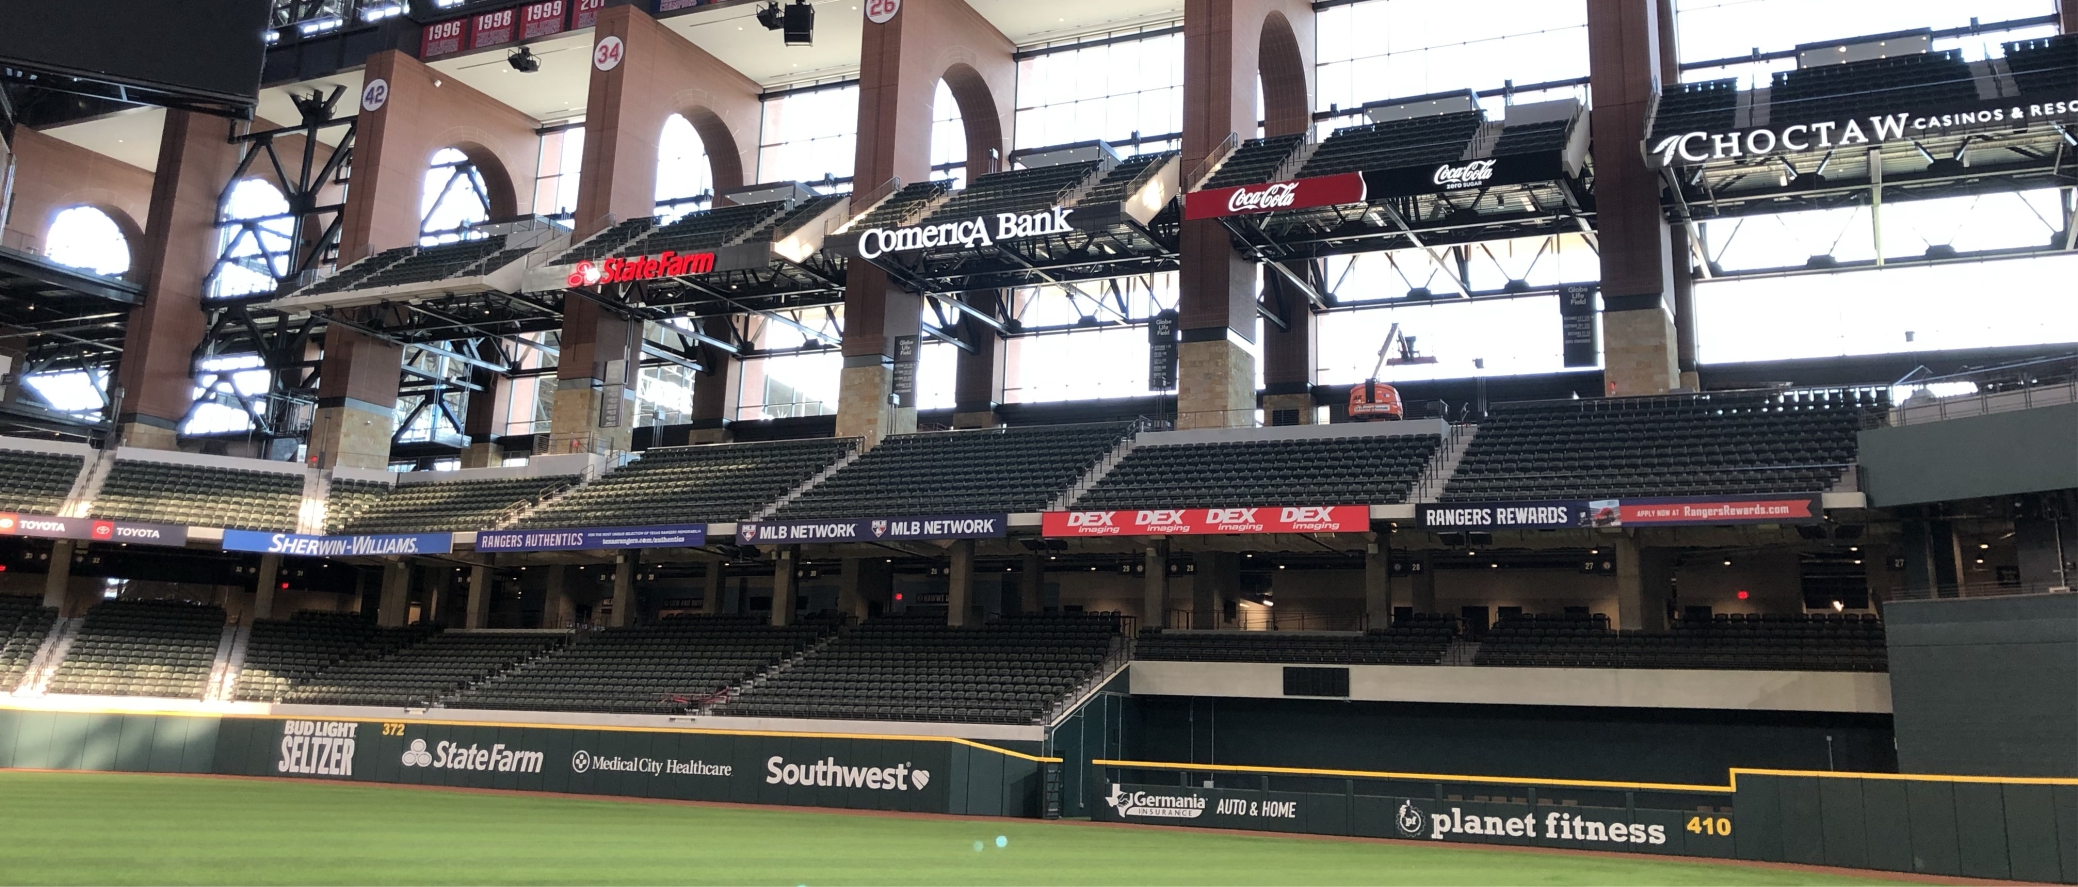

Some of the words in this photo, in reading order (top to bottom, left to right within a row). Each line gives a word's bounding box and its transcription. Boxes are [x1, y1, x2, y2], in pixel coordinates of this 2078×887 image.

[527, 0, 562, 21] 1999
[871, 0, 895, 16] 26
[478, 10, 511, 30] 1998
[428, 21, 460, 40] 1996
[597, 43, 619, 64] 34
[365, 86, 385, 104] 42
[1678, 113, 1910, 162] CHOCTAW
[1914, 108, 2004, 130] CASINOS
[2011, 106, 2024, 119] &
[1433, 159, 1497, 185] Coca-Cola
[1228, 182, 1299, 212] Coca-Cola
[996, 206, 1074, 240] Bank
[1067, 511, 1116, 527] DEX
[1135, 510, 1186, 525] DEX
[1205, 508, 1258, 524] DEX
[1280, 507, 1334, 523] DEX
[1426, 508, 1491, 526] RANGERS
[1497, 506, 1568, 525] REWARDS
[1684, 504, 1789, 519] RangersRewards.com
[19, 520, 65, 532] TOYOTA
[117, 527, 160, 539] TOYOTA
[760, 526, 787, 539] MLB
[791, 523, 856, 538] NETWORK
[891, 521, 921, 536] MLB
[924, 519, 994, 535] NETWORK
[1078, 525, 1120, 534] imaging
[1147, 524, 1190, 533] imaging
[1218, 522, 1263, 532] imaging
[1292, 521, 1340, 531] imaging
[268, 533, 416, 555] SHERWIN-WILLIAMS
[481, 535, 523, 549] RANGERS
[525, 532, 584, 548] AUTHENTICS
[1412, 563, 1420, 571] 28
[1585, 562, 1594, 570] 27
[1895, 558, 1905, 567] 27
[284, 720, 312, 736] BUD
[315, 722, 357, 738] LIGHT
[382, 722, 405, 736] 372
[278, 736, 355, 775] SELTZER
[592, 755, 638, 772] Medical
[638, 758, 663, 777] City
[666, 759, 732, 776] Healthcare
[766, 756, 908, 791] Southwest
[1134, 791, 1205, 809] Germania
[1216, 799, 1247, 816] AUTO
[1249, 802, 1259, 816] &
[1262, 801, 1297, 818] HOME
[1138, 808, 1193, 817] INSURANCE
[1431, 807, 1537, 839] planet
[1545, 812, 1666, 845] fitness
[1686, 816, 1732, 837] 410
